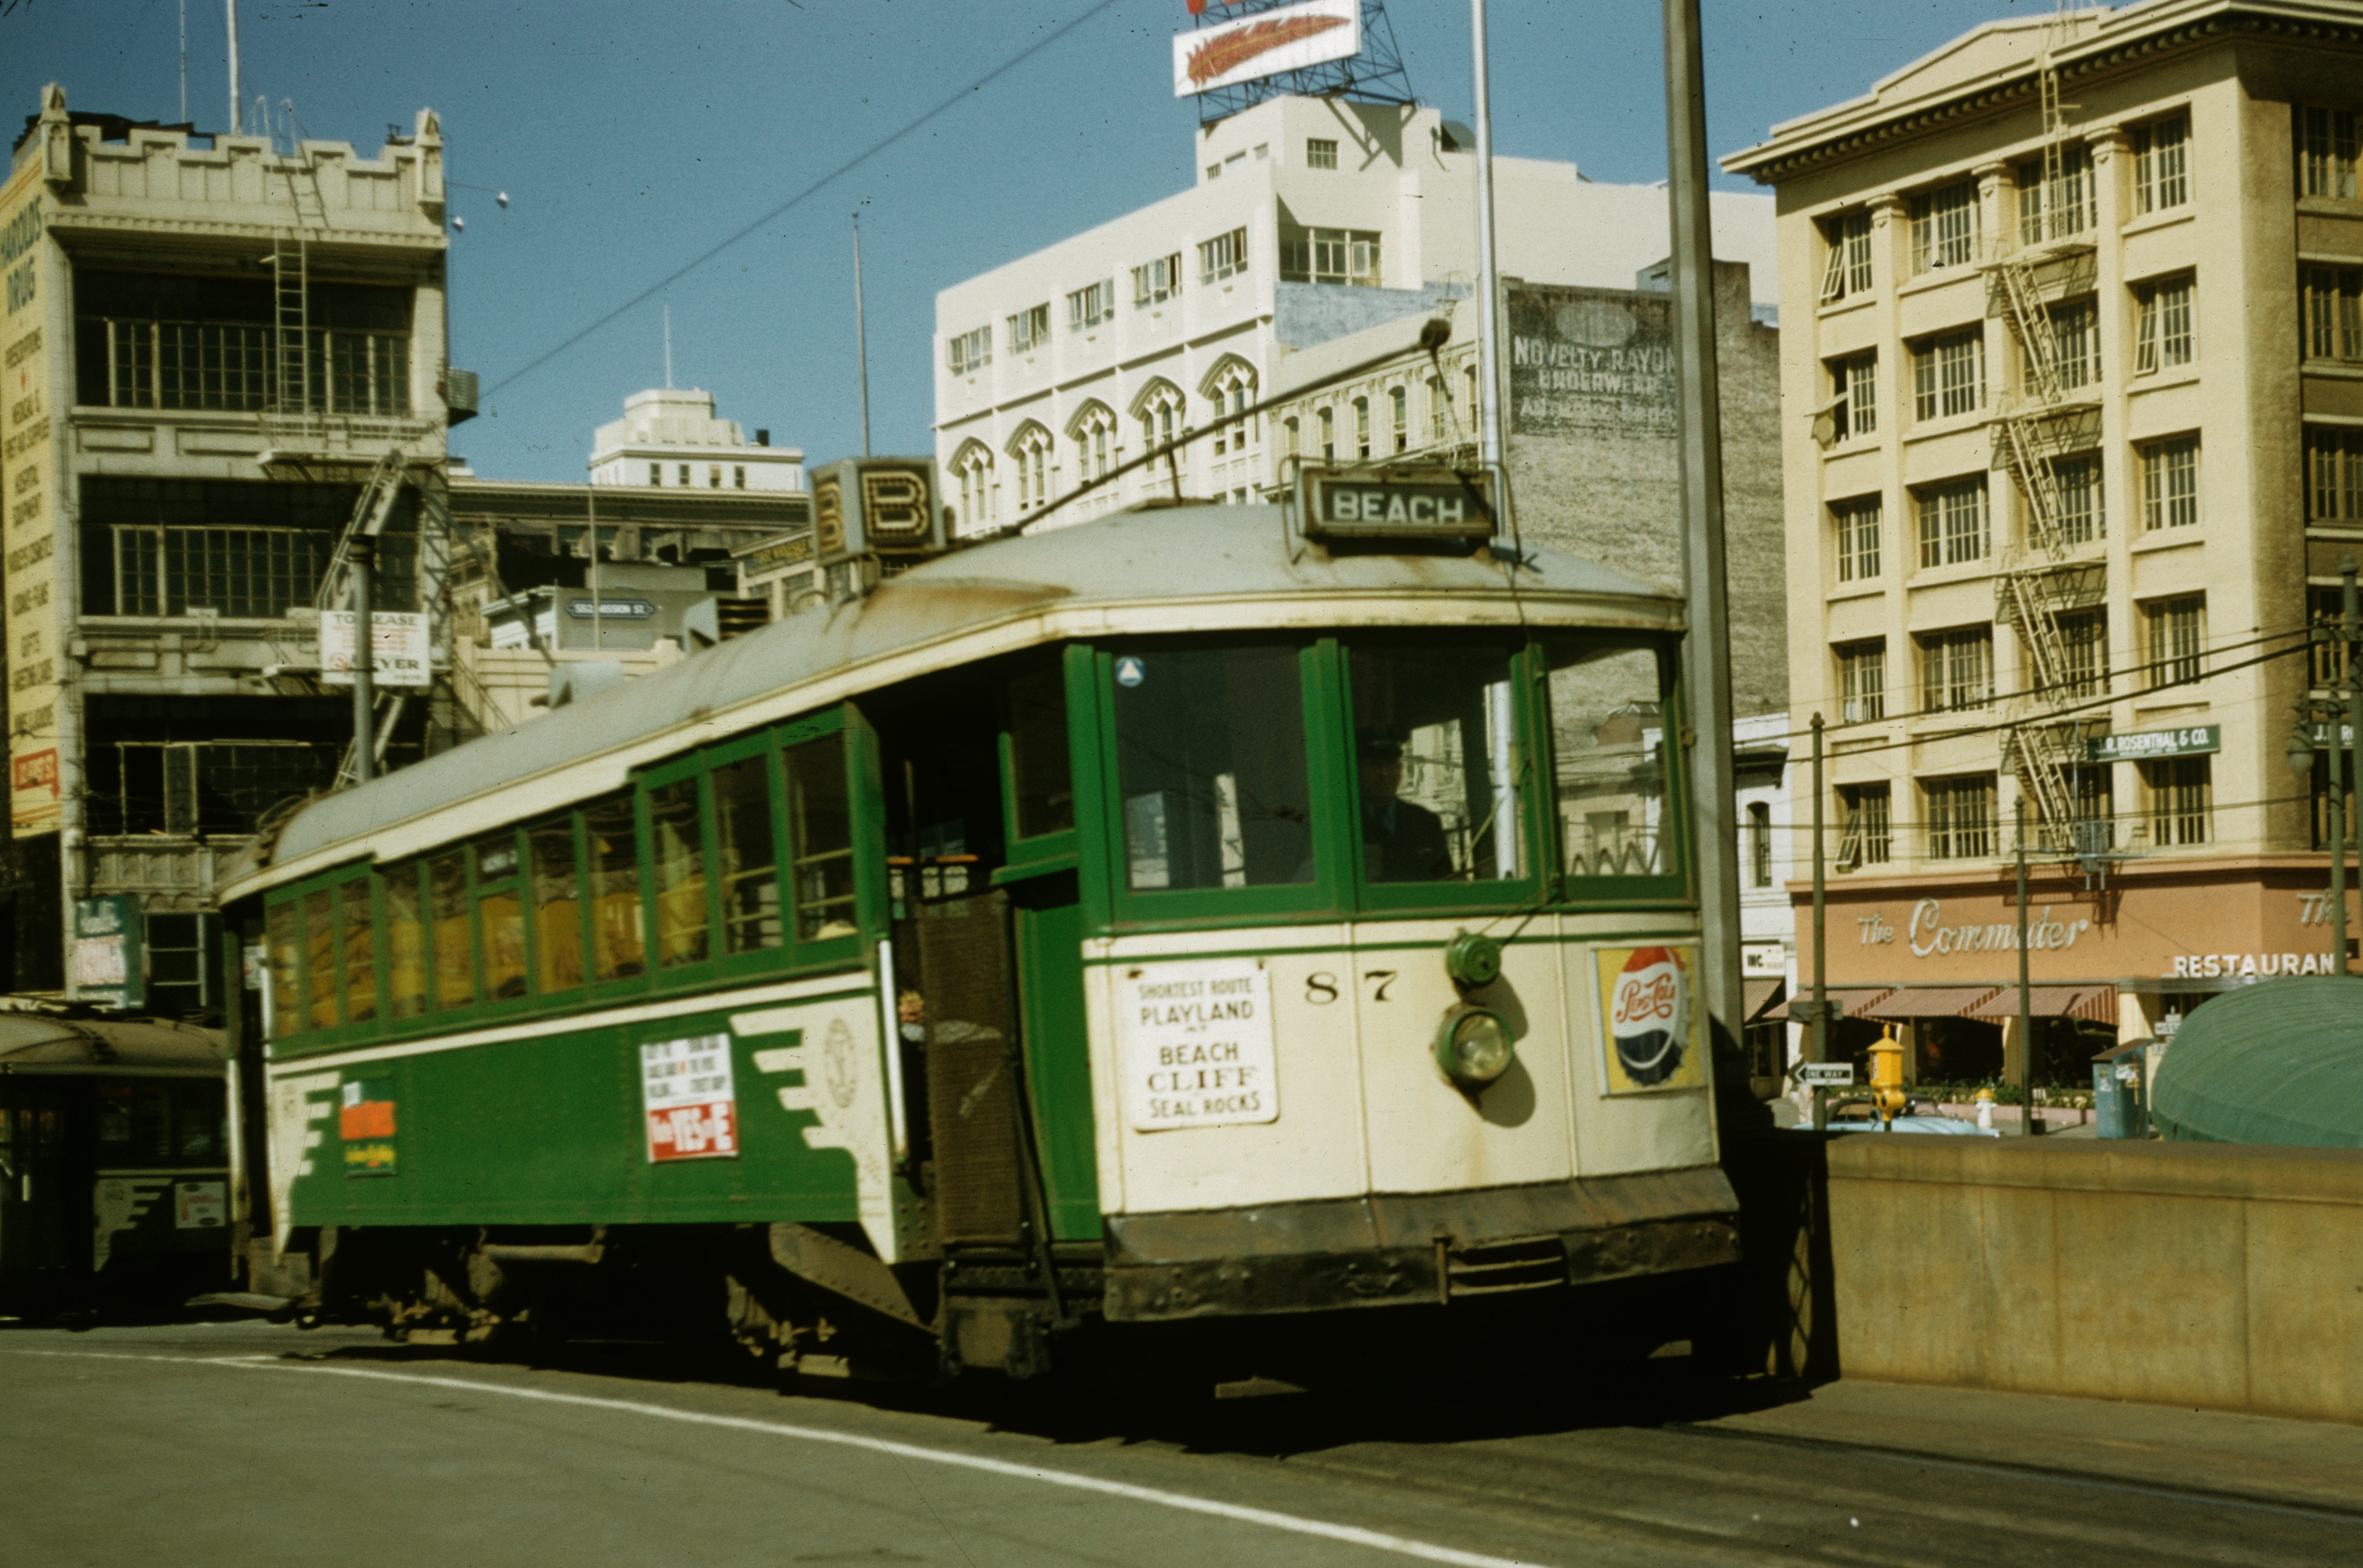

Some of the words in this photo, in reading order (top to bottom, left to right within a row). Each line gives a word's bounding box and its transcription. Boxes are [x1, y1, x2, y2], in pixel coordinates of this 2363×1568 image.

[7, 255, 35, 317] DRUG
[1515, 336, 1602, 369] NOVELTY
[861, 469, 929, 537] B
[1333, 489, 1463, 525] BEACH
[372, 615, 417, 626] EASE
[2117, 732, 2178, 752] ROSENTHAL
[2179, 730, 2189, 747] &
[2191, 728, 2209, 746] CO.
[1858, 913, 1894, 944] The
[2174, 953, 2352, 978] RESTAURAN
[1210, 977, 1253, 995] ROUTE
[1141, 1000, 1254, 1026] PLAYLAND
[1159, 1042, 1239, 1066] BEACH
[1147, 1066, 1257, 1092] CLIFF
[1805, 1069, 1821, 1078] ONE
[1823, 1069, 1844, 1078] WAY
[1150, 1099, 1197, 1119] SEAL
[1204, 1091, 1261, 1114] ROCKS
